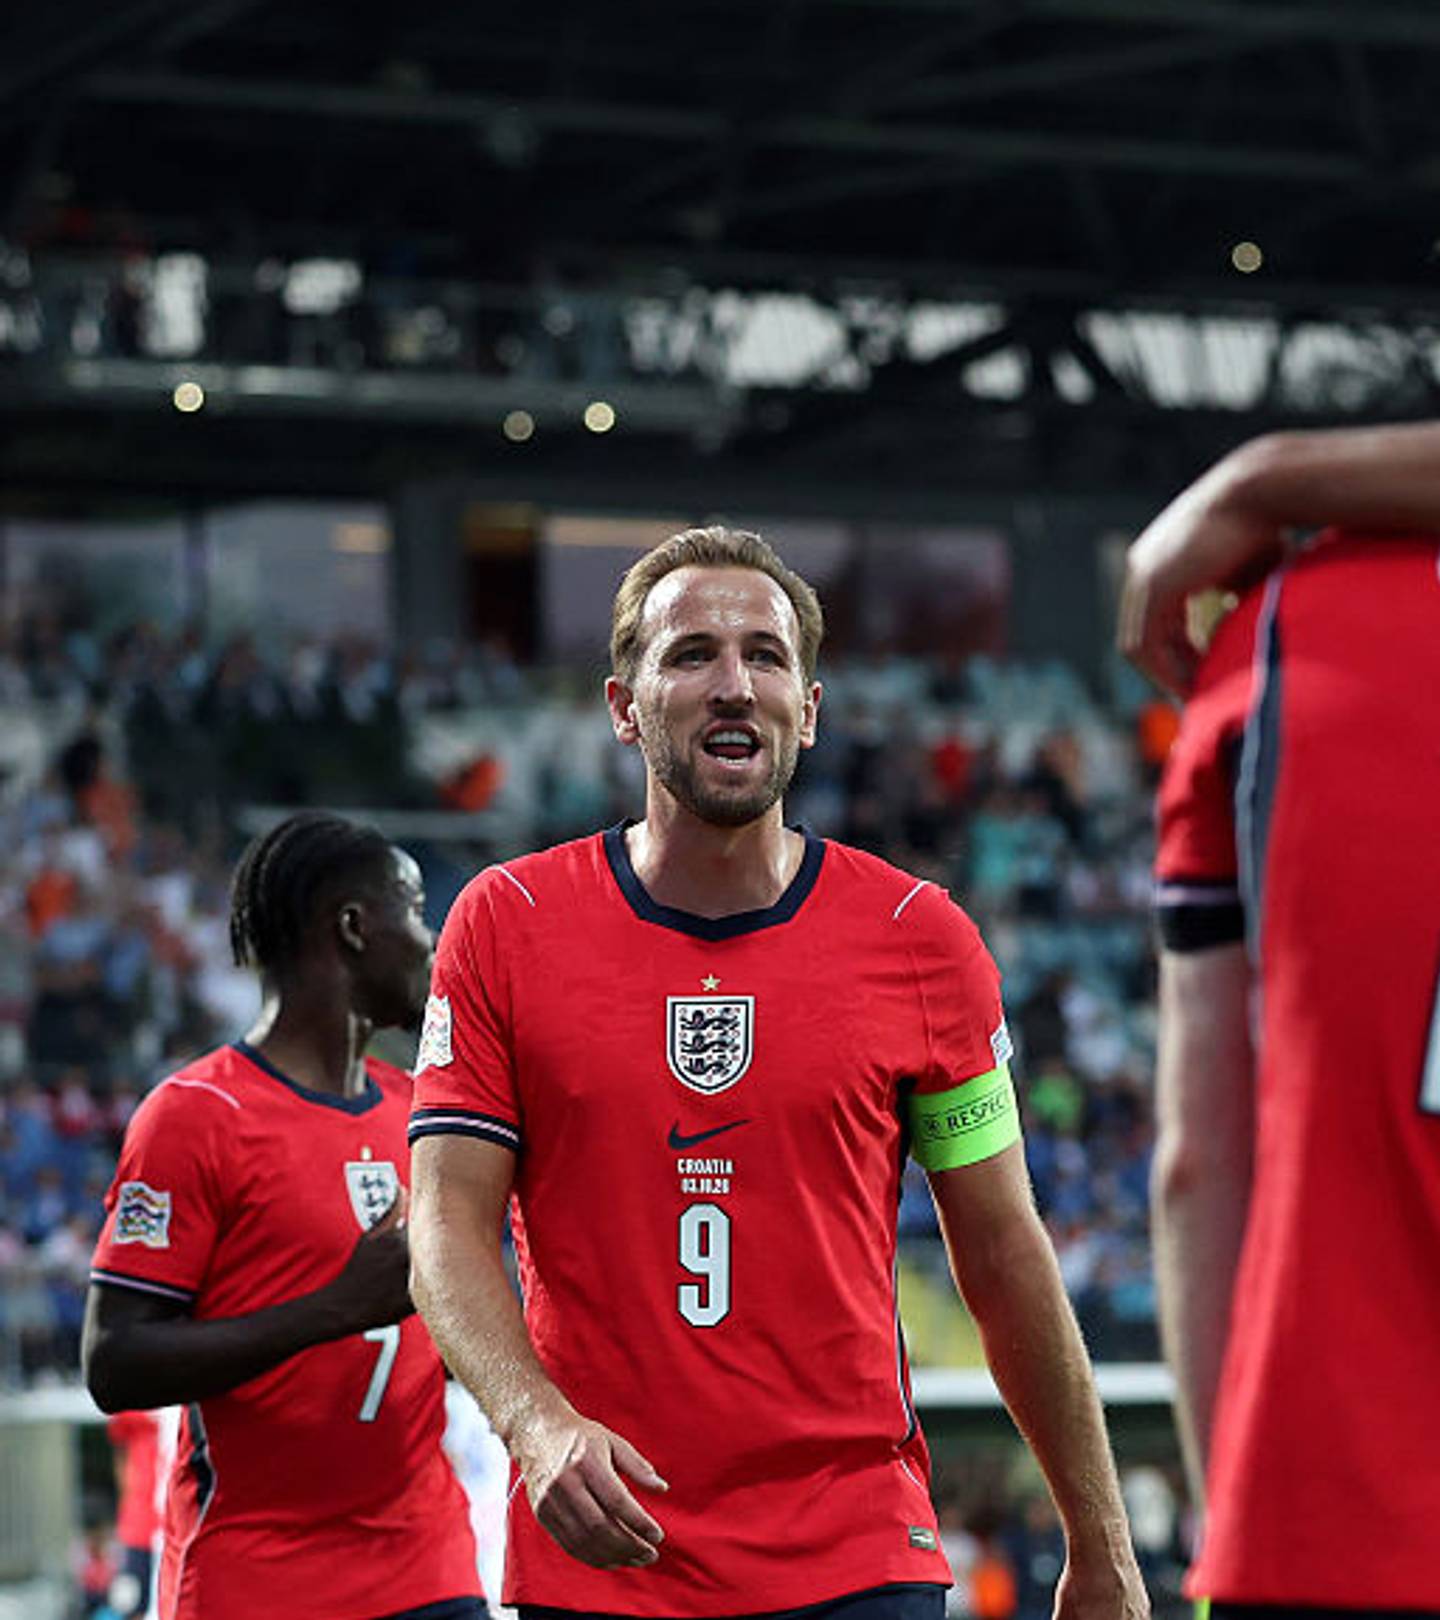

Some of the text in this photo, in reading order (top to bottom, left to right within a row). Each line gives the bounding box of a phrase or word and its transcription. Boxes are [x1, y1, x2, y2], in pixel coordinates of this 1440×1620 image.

[677, 1158, 735, 1174] CROATIA
[677, 1203, 731, 1328] 9
[358, 1324, 400, 1422] 7
